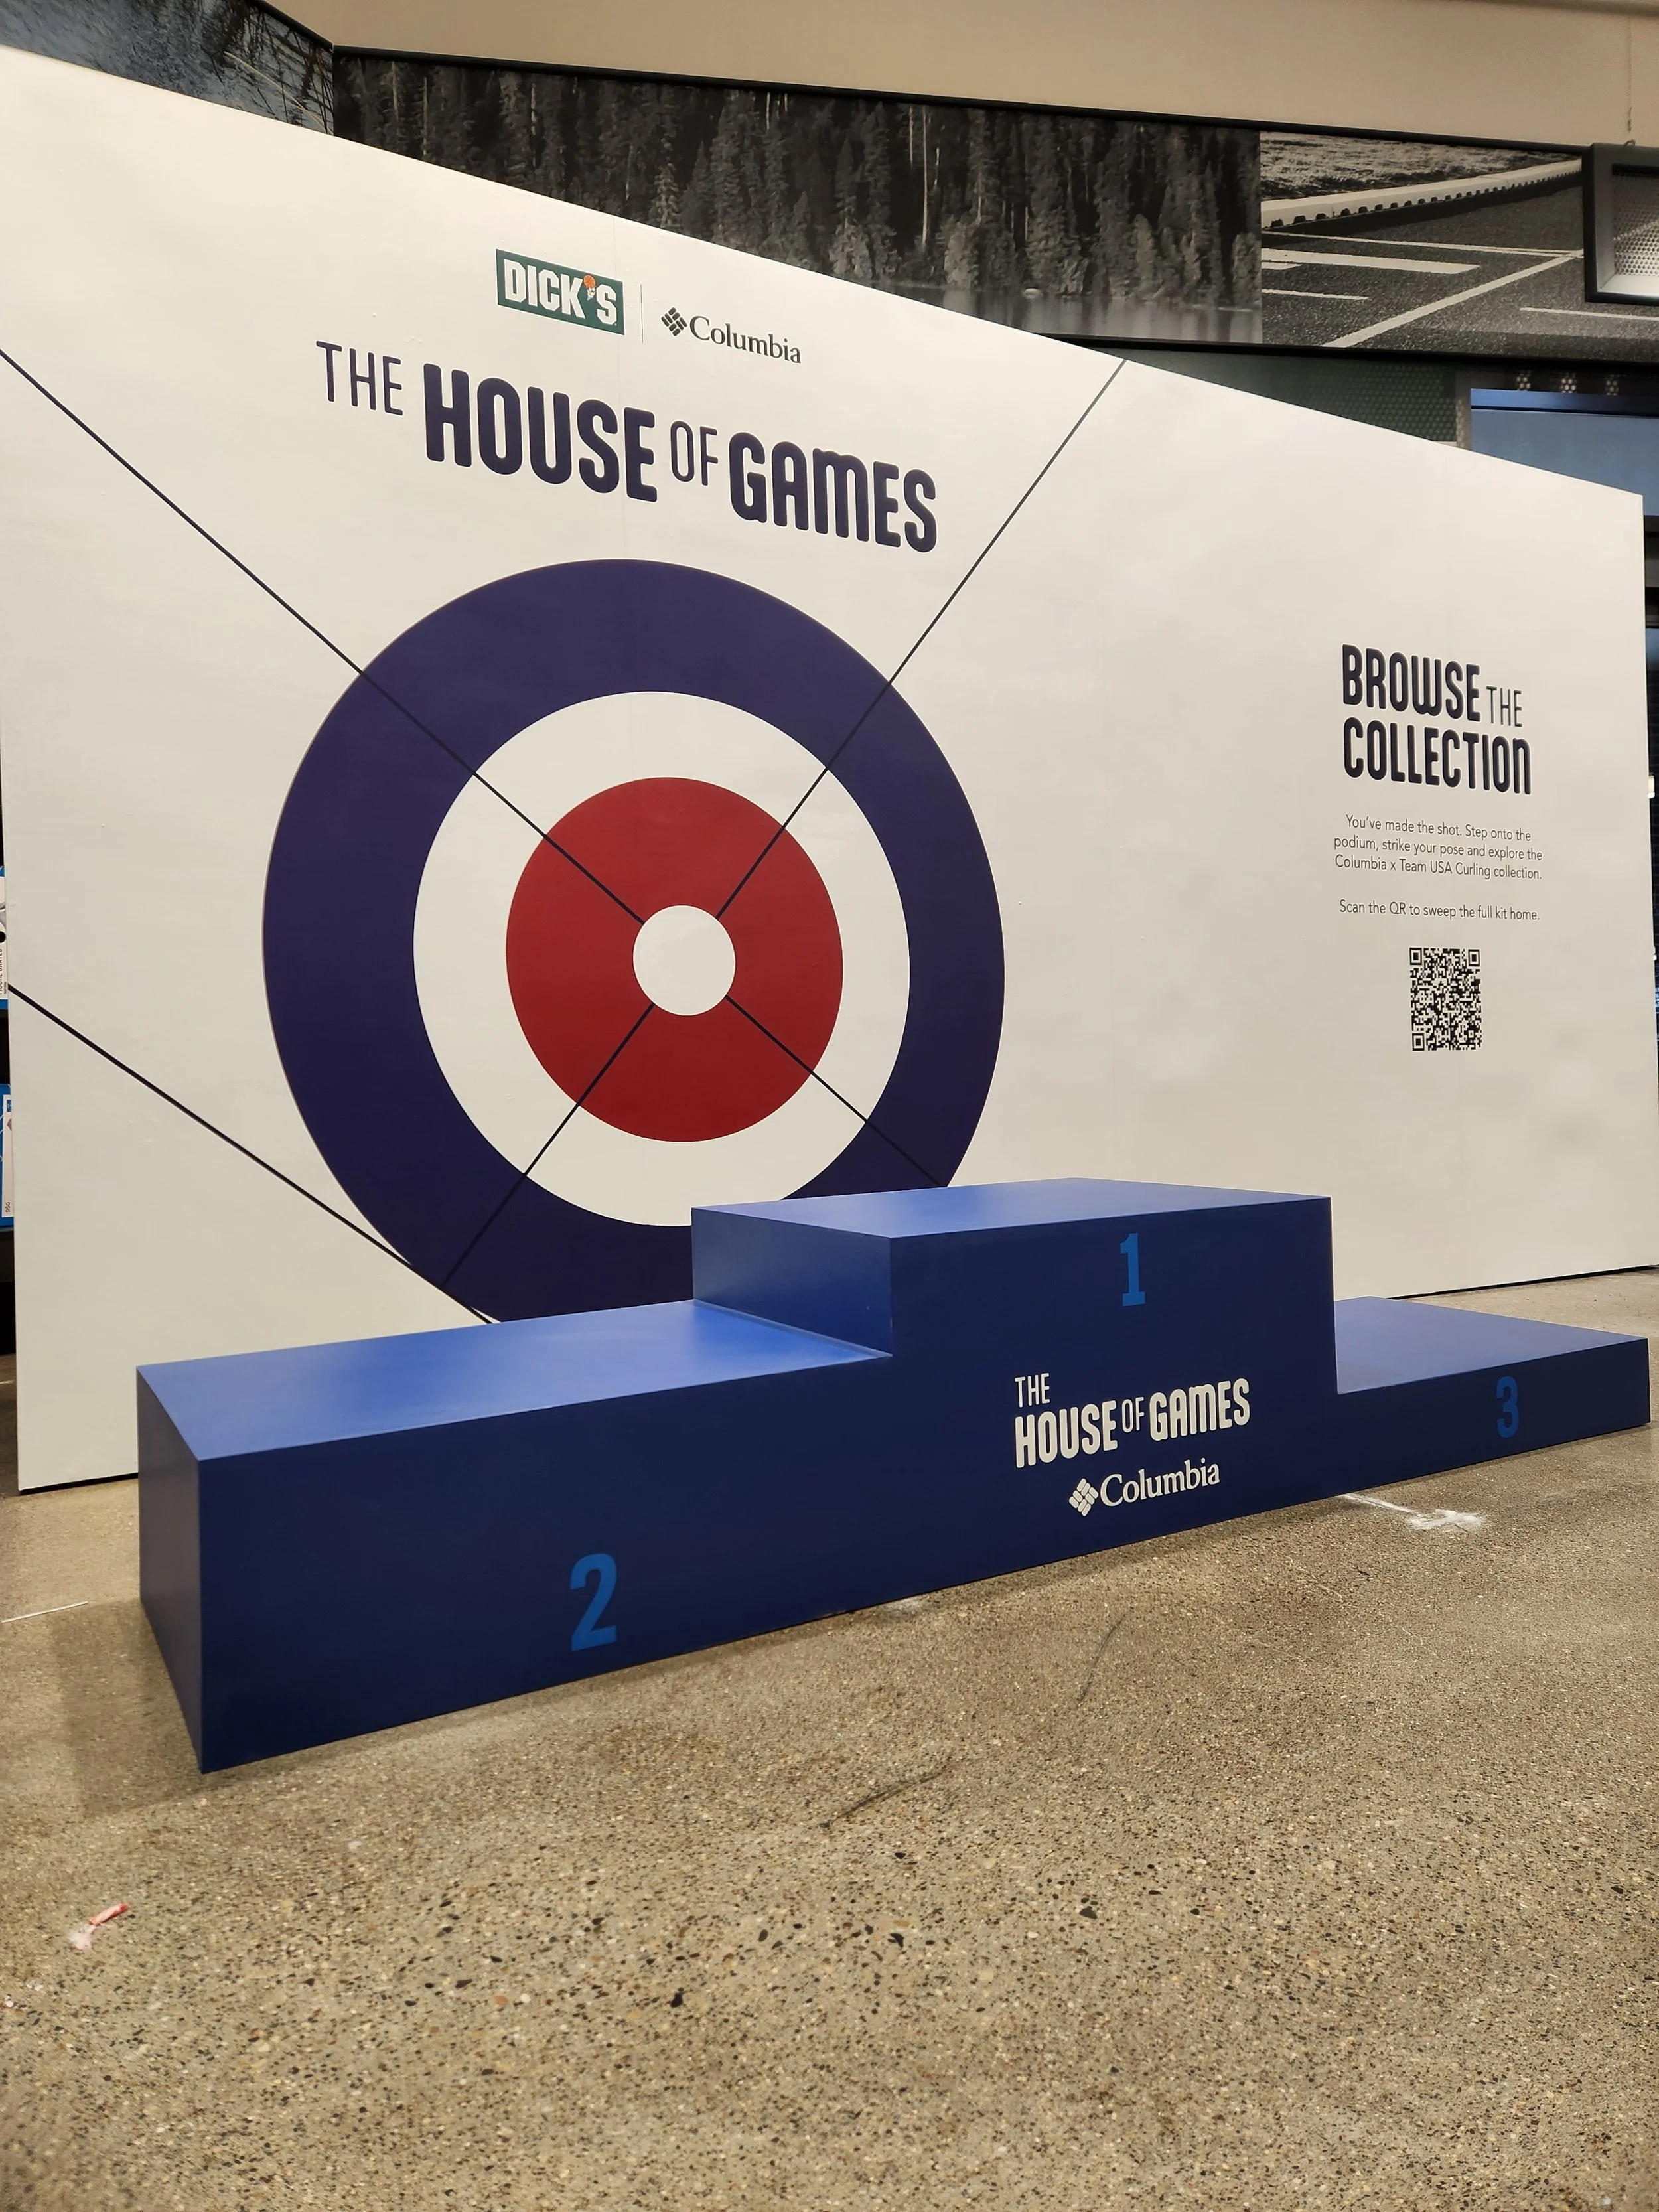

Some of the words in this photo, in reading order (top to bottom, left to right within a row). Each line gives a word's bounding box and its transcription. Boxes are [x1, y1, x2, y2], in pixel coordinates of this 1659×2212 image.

[504, 259, 618, 326] DICK'S
[689, 315, 801, 364] Columbia
[316, 341, 403, 416] THE
[423, 363, 658, 502] HOUSE
[671, 420, 719, 486] OF
[729, 431, 936, 553] GAMES
[1342, 644, 1480, 721] BROWSE
[1486, 686, 1522, 727] THE
[1344, 717, 1532, 795] COLLECTION
[1334, 836, 1379, 851] podium,
[1382, 838, 1410, 852] strike
[1413, 842, 1437, 857] your
[1440, 844, 1464, 857] pose
[1467, 844, 1486, 857] and
[1489, 846, 1524, 861] explore
[1528, 848, 1542, 861] the
[1346, 814, 1382, 830] You've
[1385, 820, 1414, 833] made
[1417, 820, 1434, 834] the
[1437, 822, 1462, 836] shot.
[1465, 824, 1488, 842] Step
[1491, 829, 1513, 840] onto
[1516, 828, 1532, 842] the
[1335, 855, 1387, 871] Columbia
[1390, 861, 1396, 870] x
[1399, 859, 1427, 873] Team
[1430, 860, 1453, 873] USA
[1455, 862, 1490, 879] Curling
[1494, 865, 1542, 880] collection.
[1340, 899, 1365, 914] Scan
[1368, 899, 1386, 915] the
[1390, 901, 1406, 915] QR
[1409, 903, 1420, 916] to
[1423, 906, 1456, 919] sweep
[1459, 904, 1475, 918] the
[1478, 905, 1492, 919] full
[1495, 906, 1507, 919] kit
[1510, 907, 1540, 921] home.
[1120, 1233, 1145, 1306] 1
[1015, 1373, 1050, 1408] THE
[1496, 1376, 1519, 1438] 3
[1015, 1400, 1118, 1468] HOUSE
[1121, 1397, 1144, 1432] OF
[1149, 1378, 1250, 1441] GAMES
[1100, 1458, 1220, 1507] Columbia
[570, 1553, 617, 1651] 2
